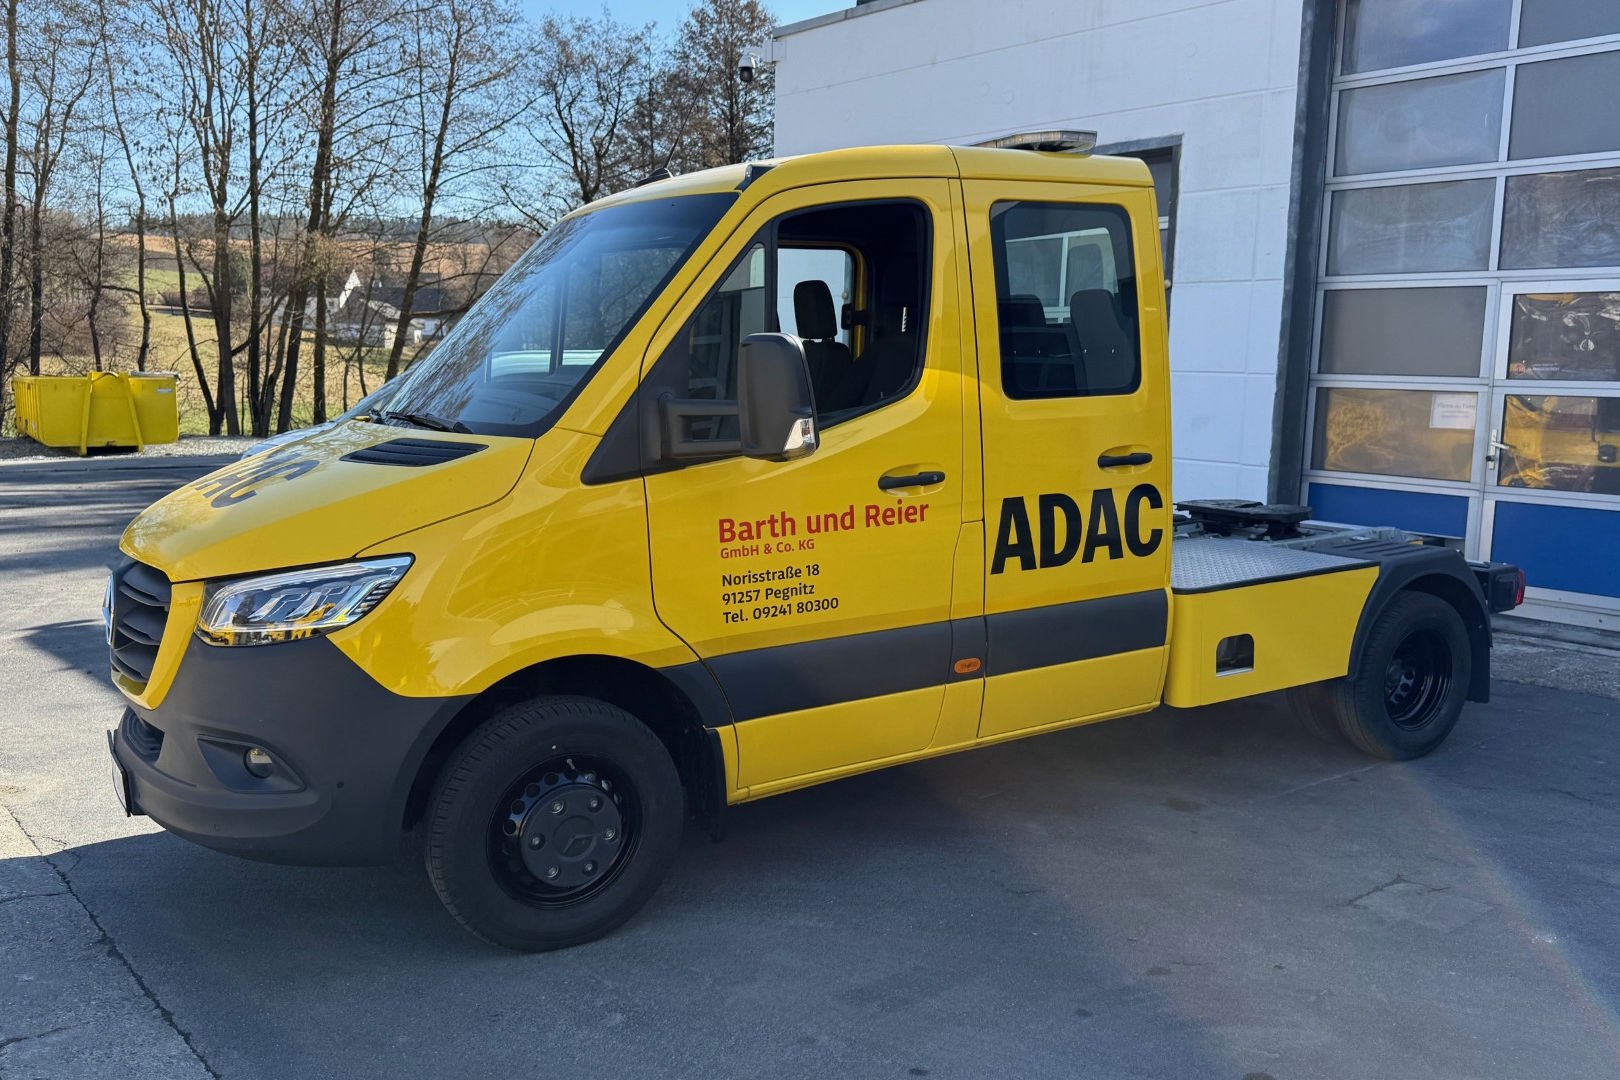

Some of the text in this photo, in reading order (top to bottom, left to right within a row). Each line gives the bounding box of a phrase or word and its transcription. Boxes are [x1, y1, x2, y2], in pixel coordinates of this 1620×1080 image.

[718, 499, 929, 543] Barth und Reier
[990, 483, 1163, 575] ADAC
[720, 538, 815, 559] GmbH & Co. KG
[722, 564, 820, 587] Norisstraße 18
[722, 583, 815, 605] 91257 Pegnitz
[722, 597, 839, 624] Tel. 09241 80300
